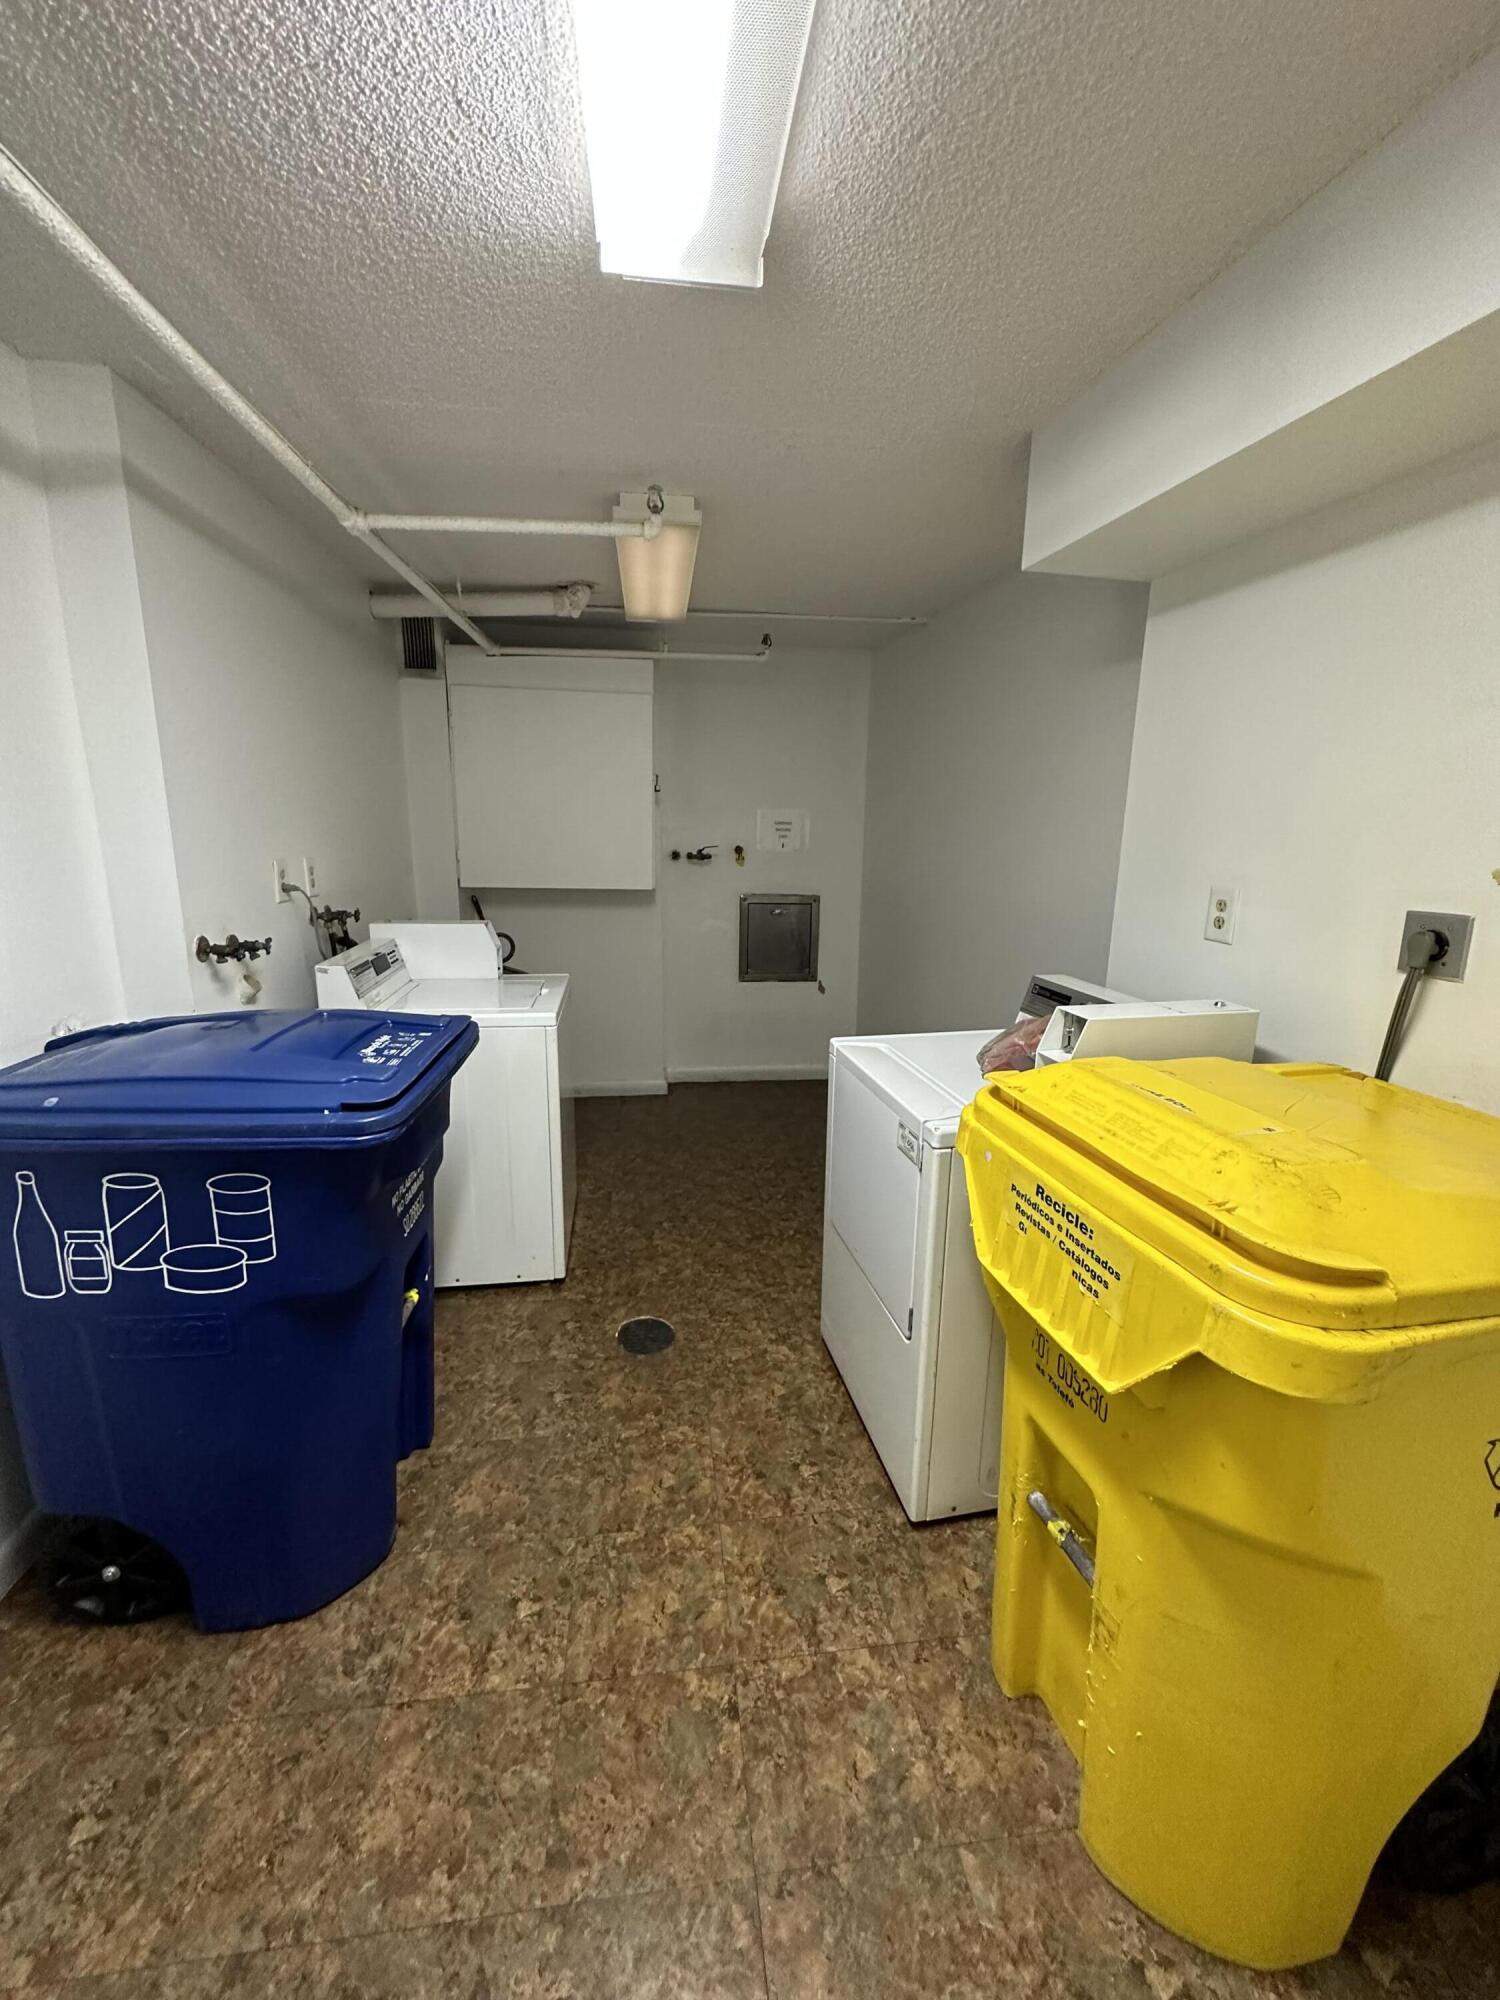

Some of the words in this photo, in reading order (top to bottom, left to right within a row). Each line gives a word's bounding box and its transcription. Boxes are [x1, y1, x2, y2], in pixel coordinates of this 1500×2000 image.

[1010, 1183, 1055, 1226] Periódicos
[1056, 1223, 1063, 1233] e
[1065, 1227, 1121, 1281] Insertados
[1015, 1201, 1051, 1239] Revistas
[1058, 1239, 1110, 1290] Catálogos
[1035, 1183, 1094, 1240] Recicle:
